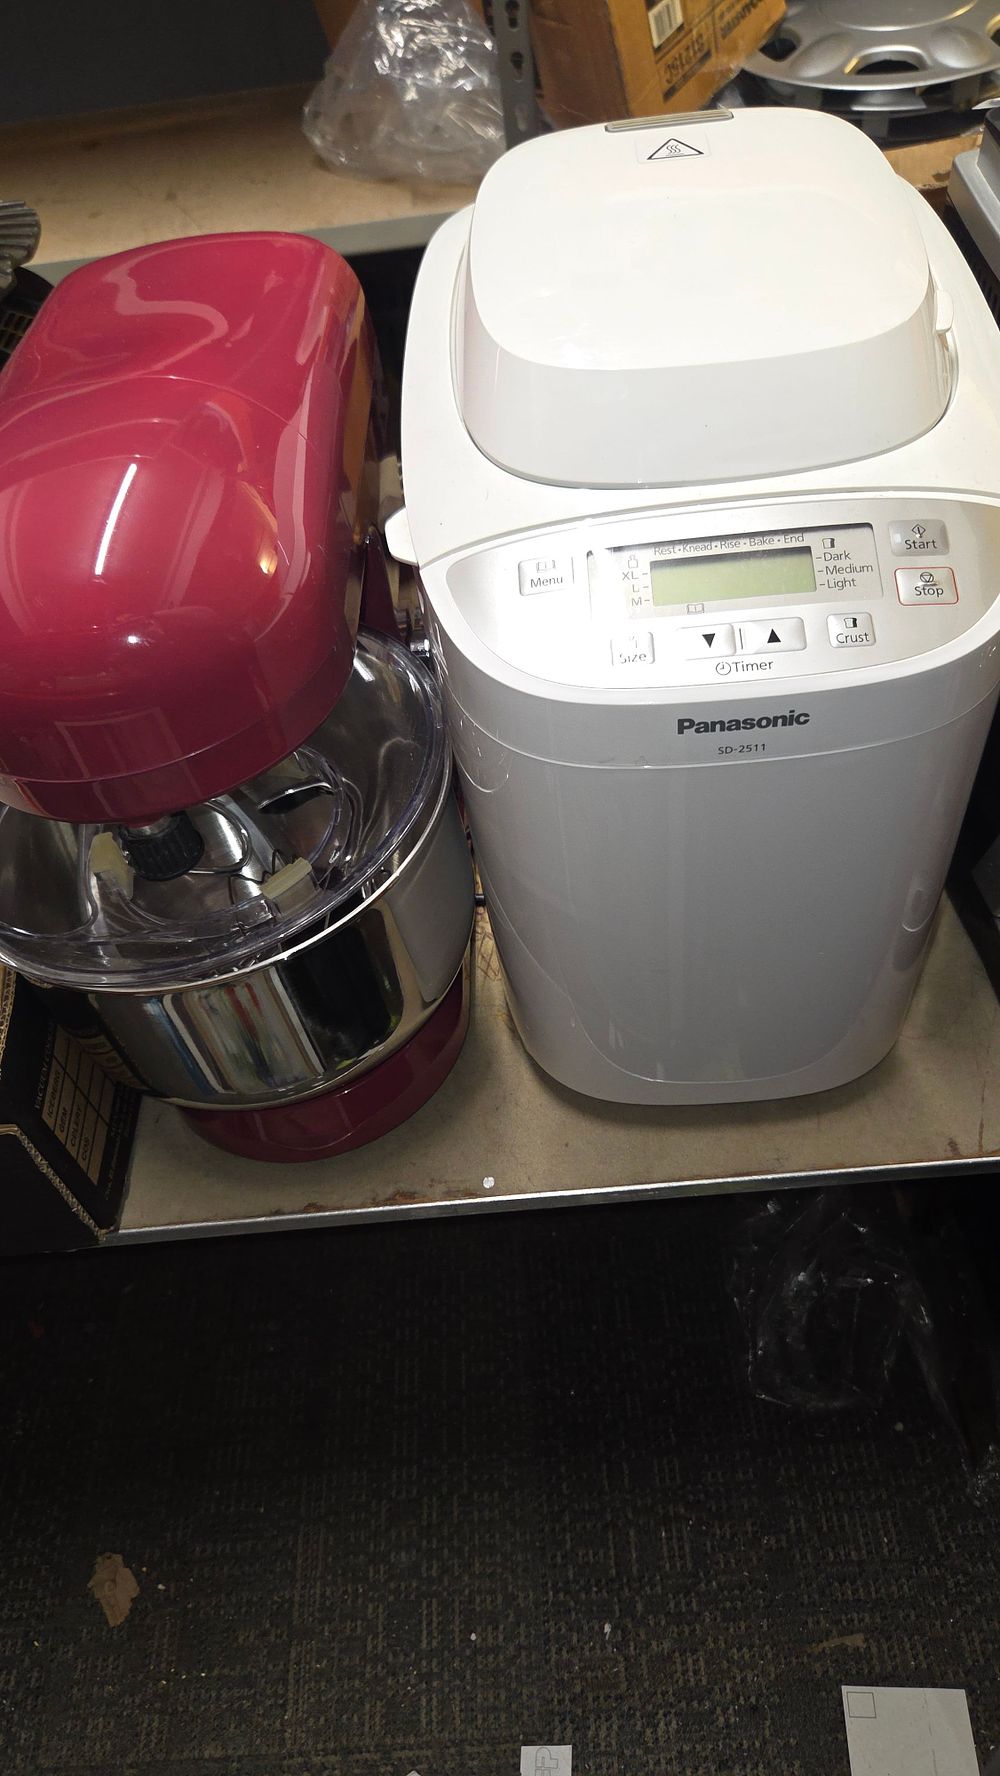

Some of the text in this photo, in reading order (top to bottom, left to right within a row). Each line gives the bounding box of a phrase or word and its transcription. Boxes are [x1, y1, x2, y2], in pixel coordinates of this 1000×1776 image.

[653, 532, 805, 556] Rest Knead Rise Bake End
[904, 538, 938, 550] Start
[823, 550, 851, 562] Dark
[825, 563, 874, 575] Medium
[622, 570, 639, 581] XL
[530, 576, 563, 588] Menu
[827, 577, 857, 591] Light
[632, 584, 640, 593] L
[914, 585, 944, 598] Stop
[631, 596, 643, 607] M
[836, 632, 870, 644] Crust
[732, 660, 774, 673] Timer
[677, 709, 811, 735] Panasonic
[718, 743, 767, 755] SD-2511
